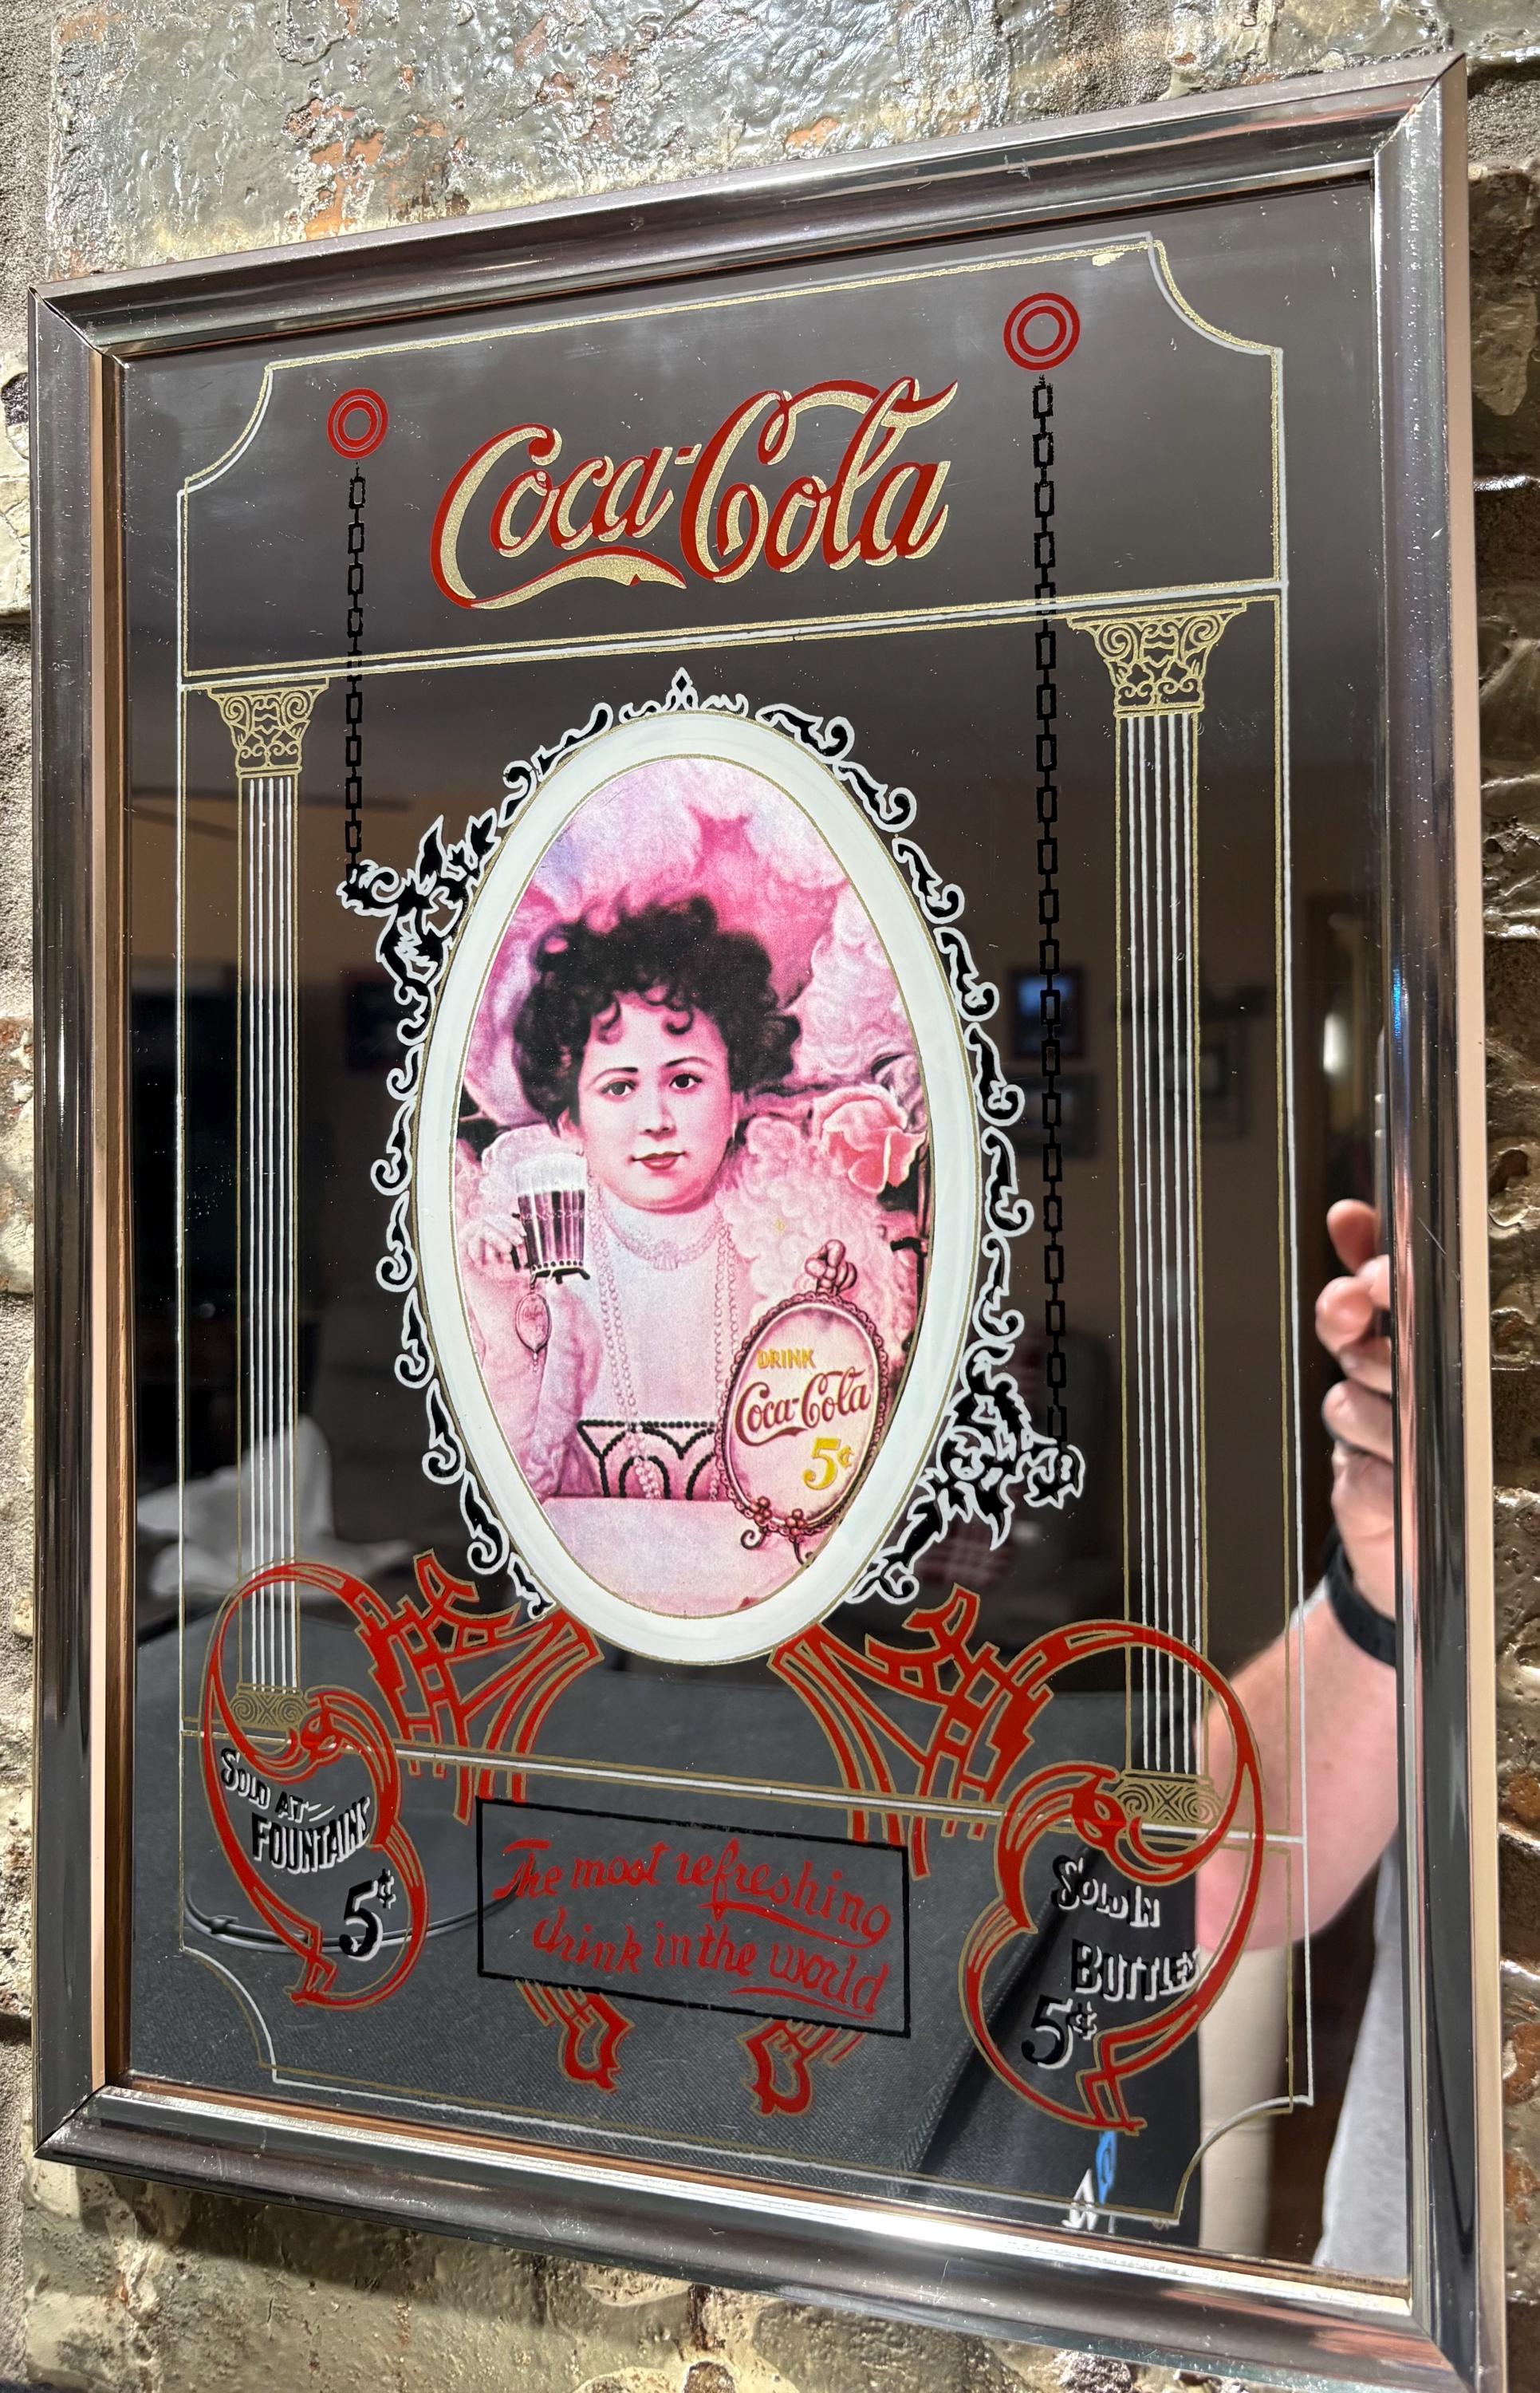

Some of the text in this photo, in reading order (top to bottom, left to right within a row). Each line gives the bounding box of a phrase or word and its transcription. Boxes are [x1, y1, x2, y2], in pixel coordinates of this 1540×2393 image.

[431, 376, 958, 609] Coca-Cola
[758, 1348, 817, 1370] DRINK
[735, 1366, 872, 1447] Coca-Cola
[802, 1437, 854, 1490] 5¢
[491, 1837, 892, 1949] The most refreshing
[532, 1907, 889, 2013] drink in the world
